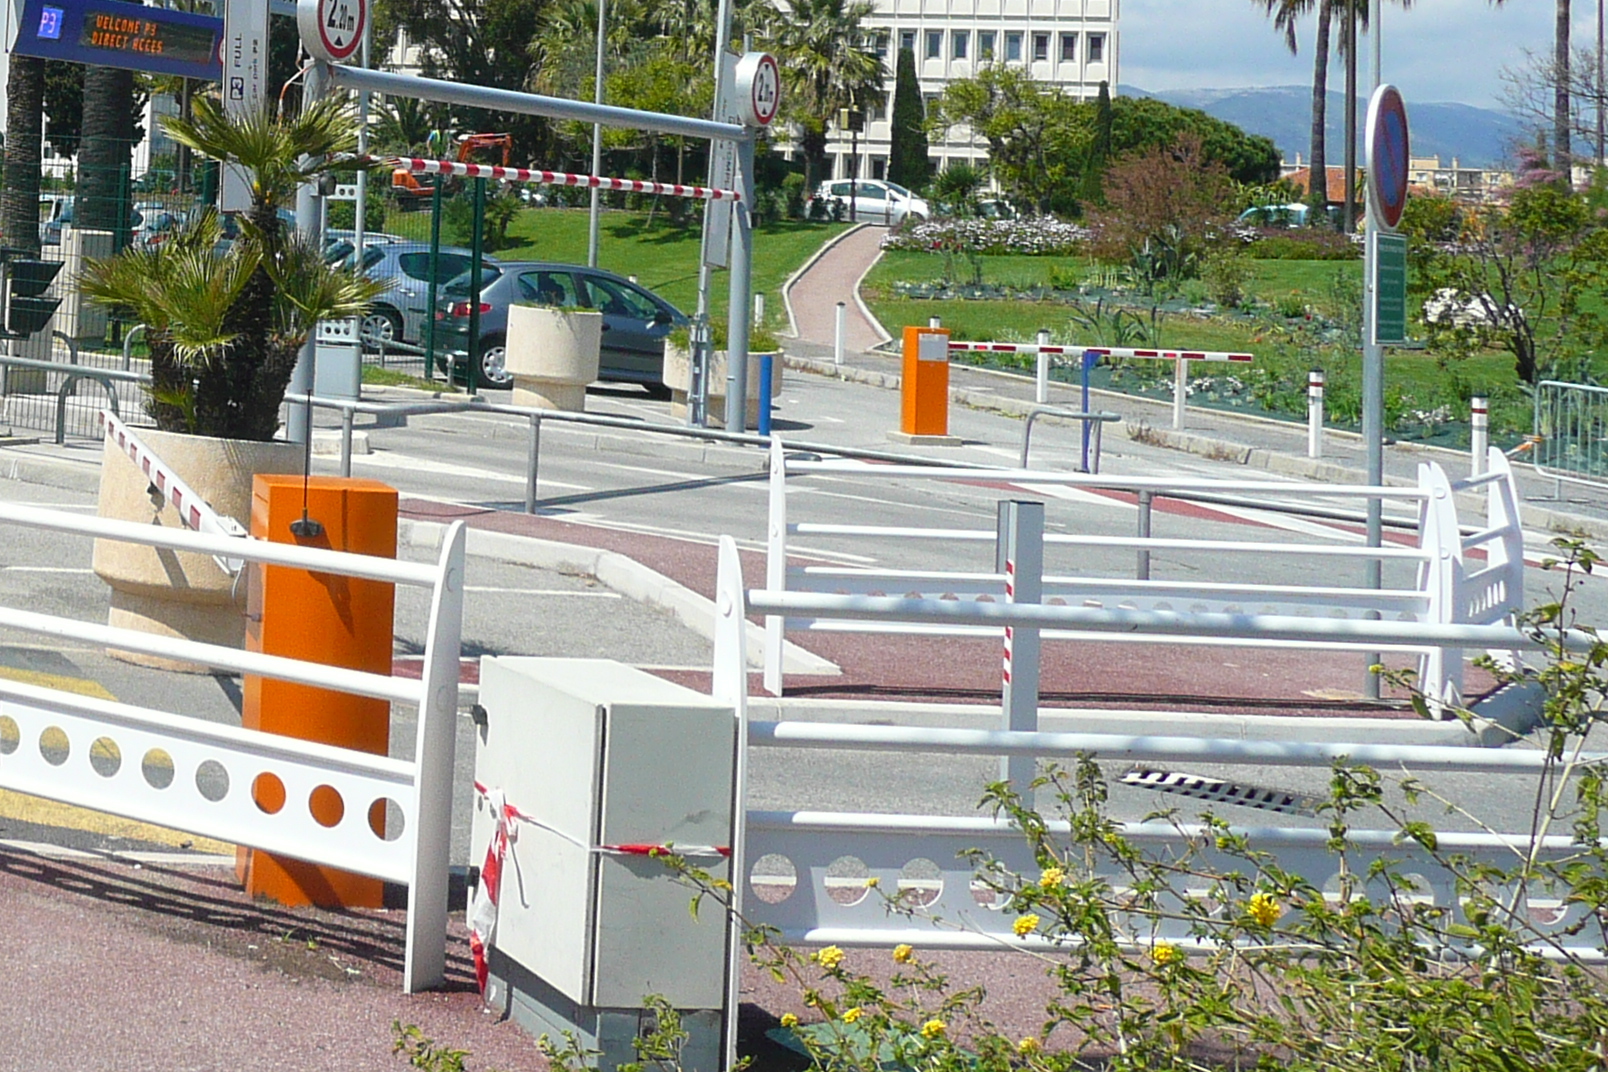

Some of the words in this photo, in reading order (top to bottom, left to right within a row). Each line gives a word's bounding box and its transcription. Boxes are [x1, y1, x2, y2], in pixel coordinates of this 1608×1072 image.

[41, 12, 57, 34] P3
[96, 14, 141, 35] WELCOME
[143, 22, 158, 37] P3
[91, 30, 128, 50] DIRECT
[132, 37, 164, 54] ACCES
[234, 33, 242, 67] FULL
[231, 78, 243, 99] P3
